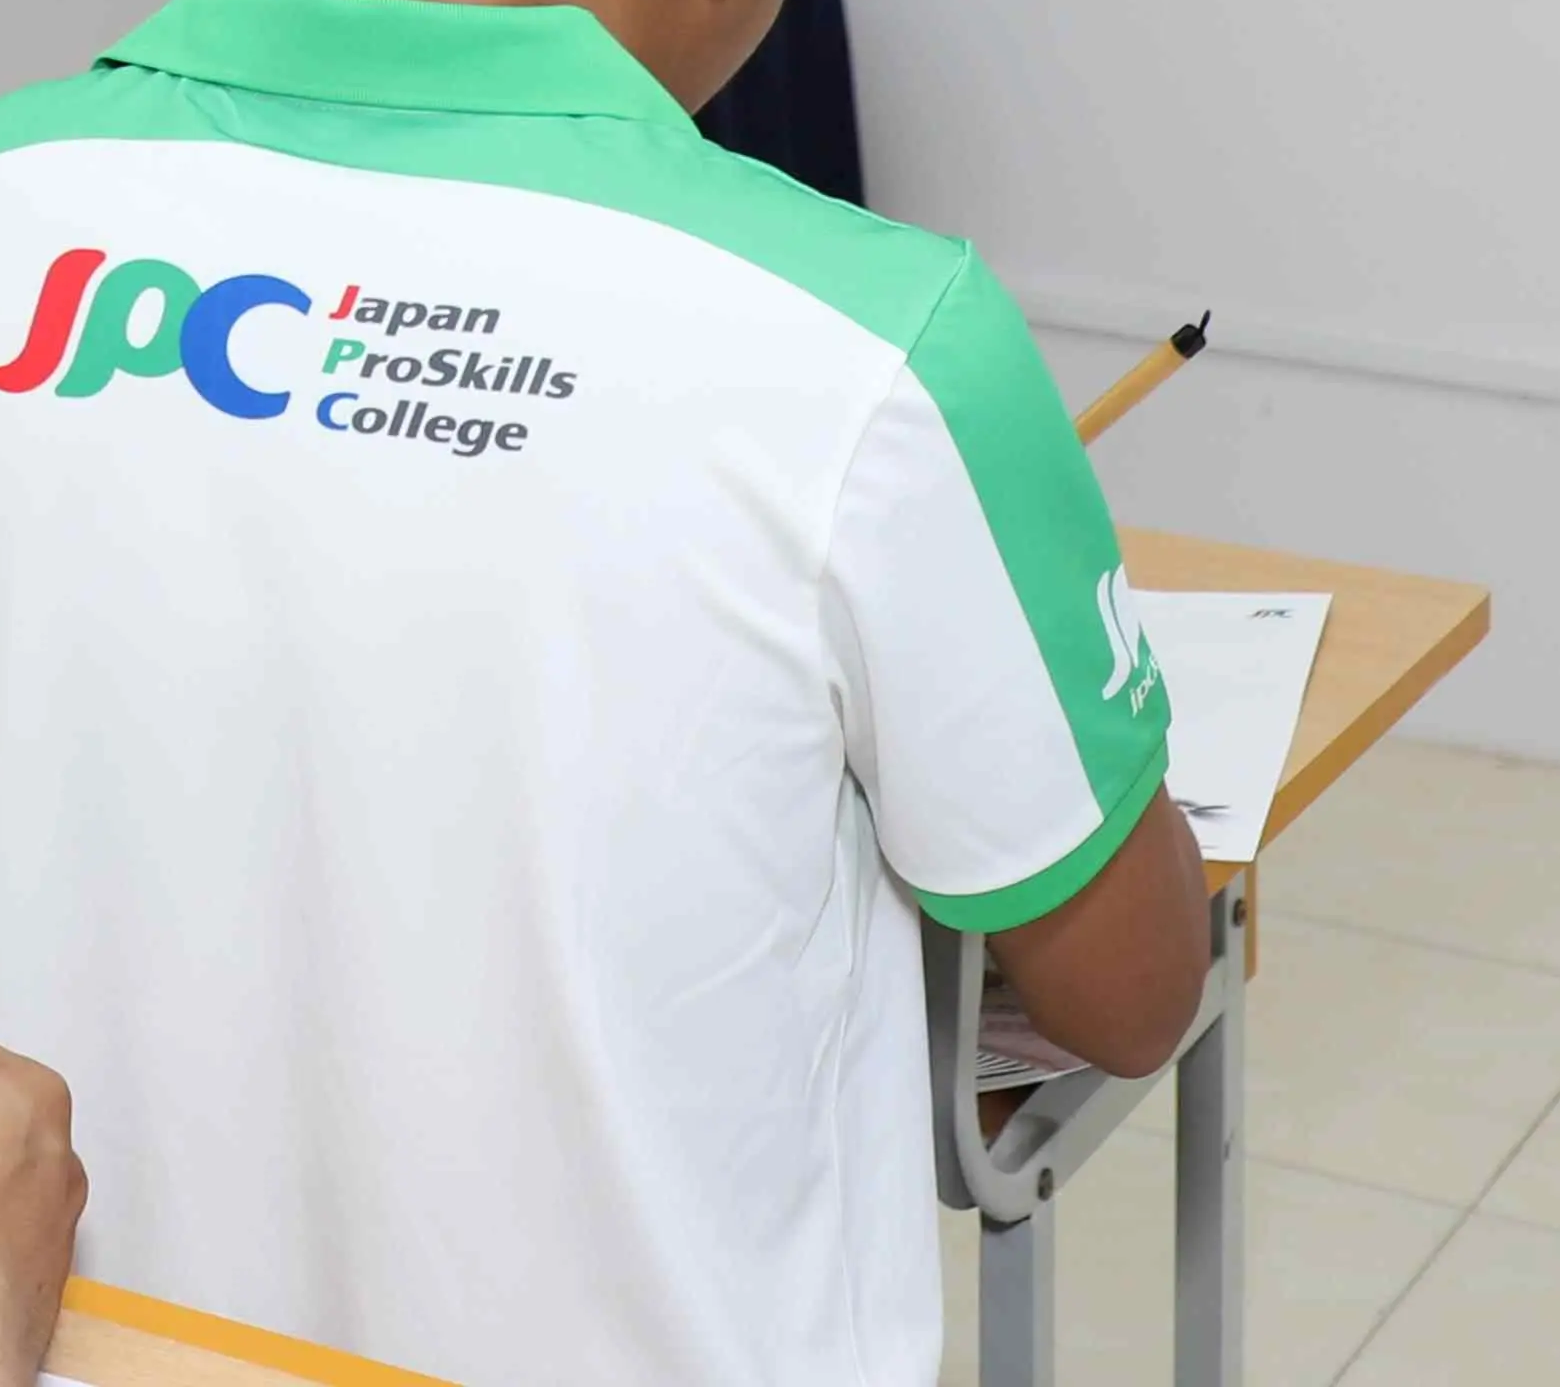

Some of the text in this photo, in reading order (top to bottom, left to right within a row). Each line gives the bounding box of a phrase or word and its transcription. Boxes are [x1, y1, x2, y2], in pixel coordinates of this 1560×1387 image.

[329, 284, 501, 337] Japan
[321, 337, 578, 399] ProSkills
[316, 391, 529, 458] College
